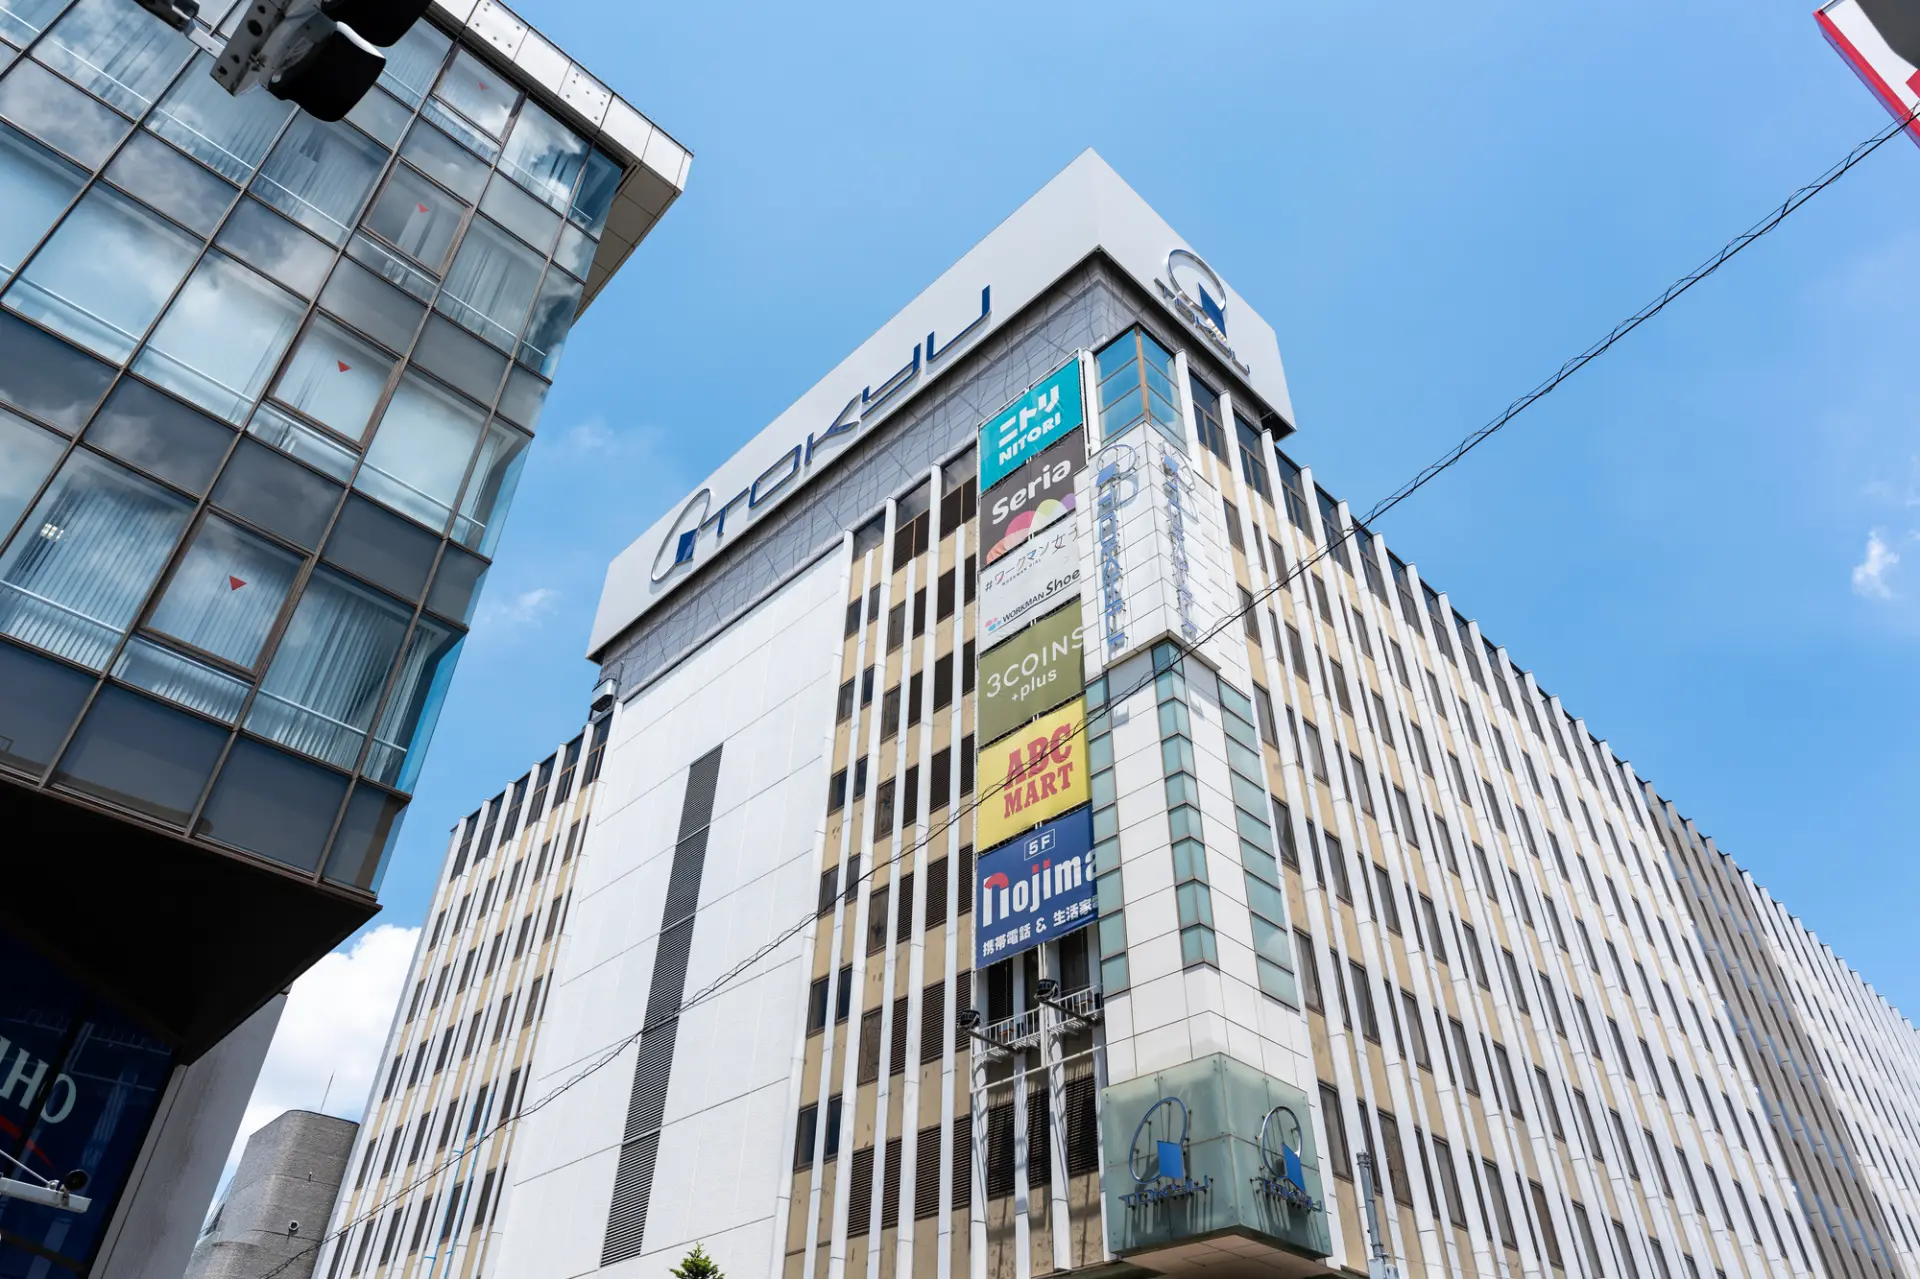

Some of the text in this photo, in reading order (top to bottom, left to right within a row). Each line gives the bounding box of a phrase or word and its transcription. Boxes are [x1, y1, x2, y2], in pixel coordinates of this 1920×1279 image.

[700, 285, 991, 538] TOKYU
[998, 385, 1060, 447] ニトリ
[999, 412, 1061, 466] NITORI
[992, 459, 1071, 525] Seria
[1002, 592, 1045, 623] WORKMAN
[987, 626, 1083, 698] 3COINS
[1012, 669, 1057, 701] +plus
[1003, 723, 1072, 790] ABC
[1004, 762, 1074, 819] MART
[1028, 834, 1050, 855] 5F
[983, 923, 1031, 957] 携帯電話
[1036, 917, 1047, 934] &
